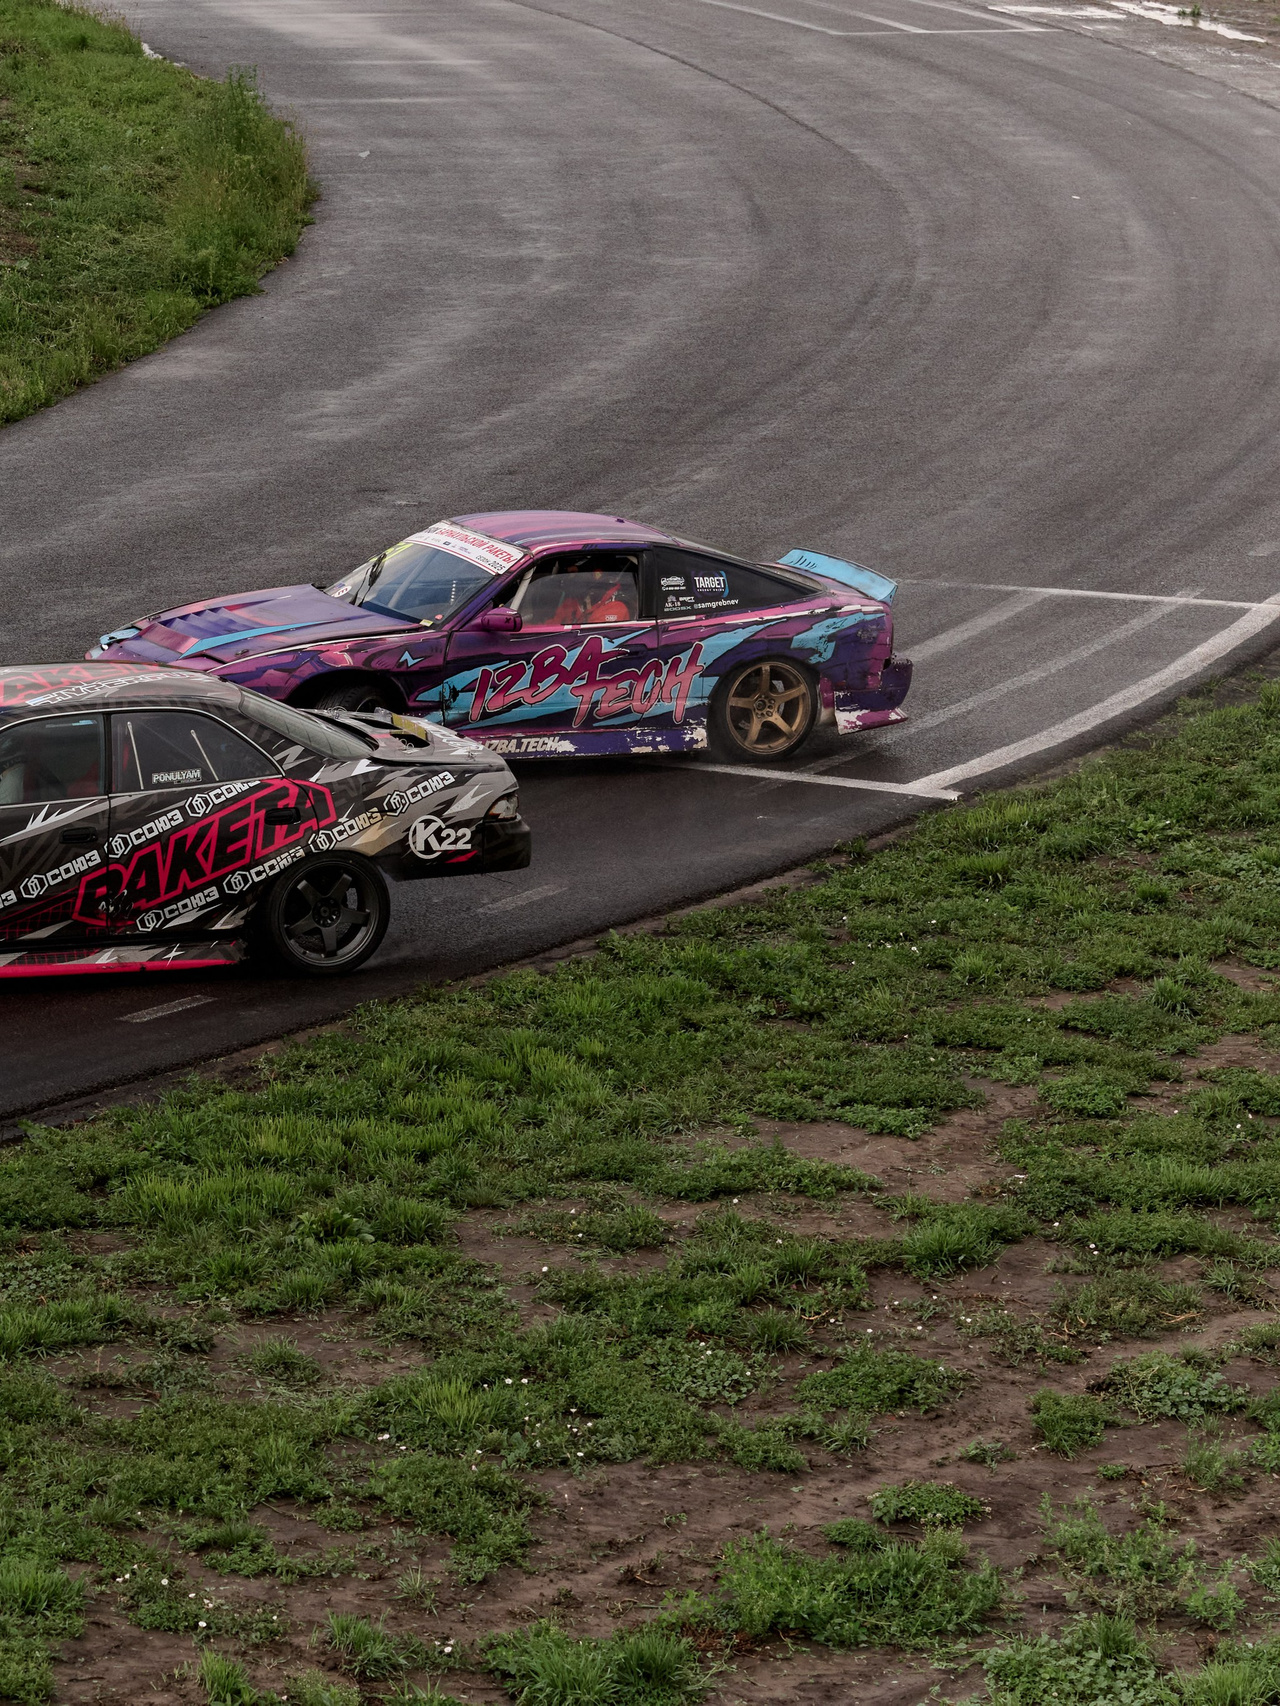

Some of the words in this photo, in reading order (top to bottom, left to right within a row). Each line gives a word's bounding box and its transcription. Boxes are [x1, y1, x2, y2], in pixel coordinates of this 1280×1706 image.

[482, 544, 518, 564] РАКЕТЫ
[694, 577, 725, 588] TARGET
[693, 599, 739, 609] @samgrebnev
[469, 636, 629, 723] IZBA
[570, 642, 705, 728] TECH
[153, 769, 200, 783] PONULYAM
